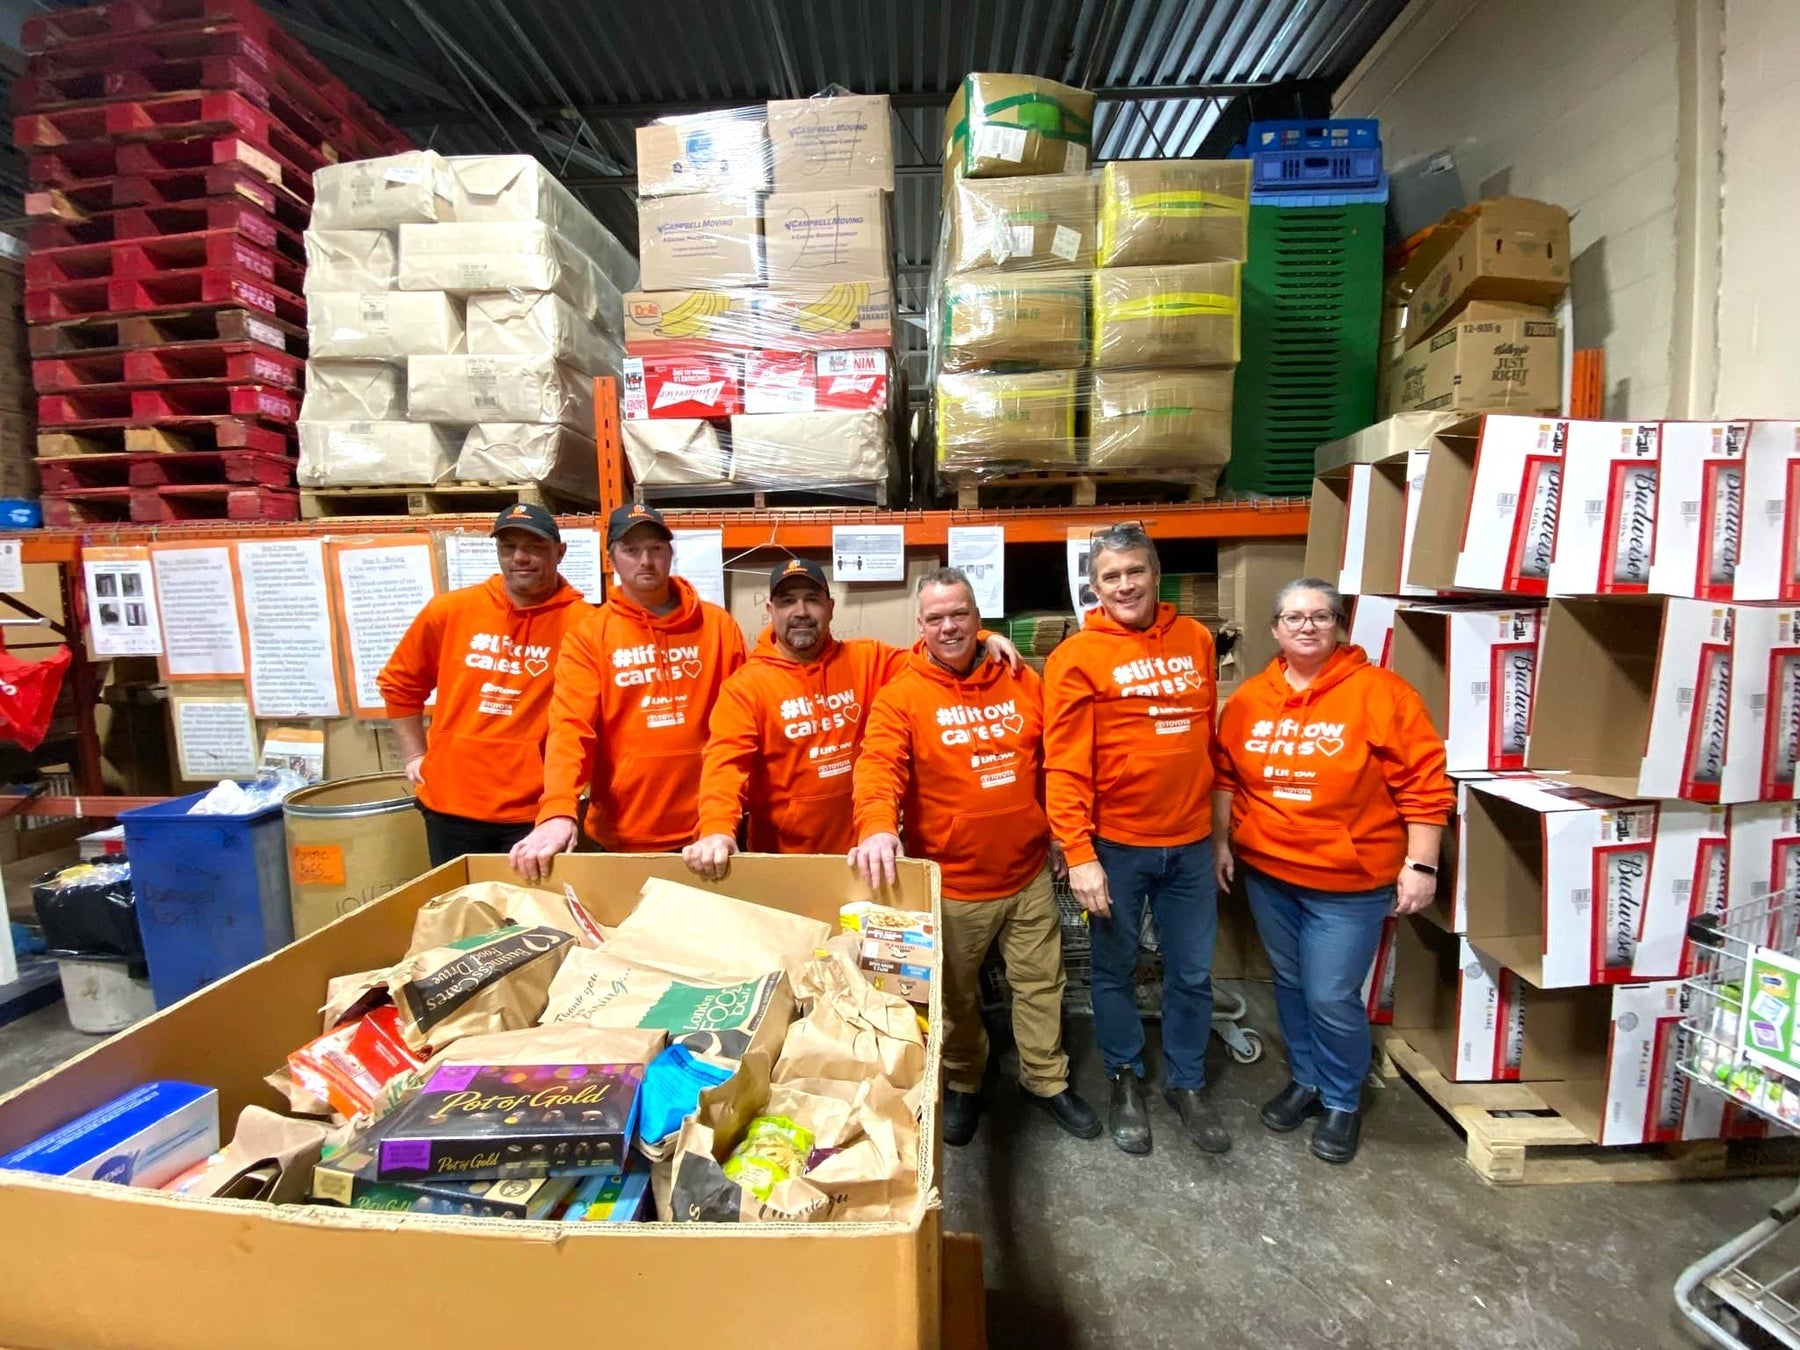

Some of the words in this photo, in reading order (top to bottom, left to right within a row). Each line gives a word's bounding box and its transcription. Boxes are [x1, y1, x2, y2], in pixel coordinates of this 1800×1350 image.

[634, 303, 658, 317] Dole
[853, 356, 875, 369] WIN
[1495, 357, 1526, 369] JUST
[1491, 369, 1529, 386] RIGHT
[1627, 470, 1657, 580] Budweiser
[470, 633, 552, 658] #lfow
[1284, 787, 1312, 796] TOYOTA
[1616, 853, 1643, 961] Budweiser
[469, 946, 504, 967] Food
[432, 965, 474, 986] Drive
[554, 994, 584, 1024] Thank
[584, 972, 600, 996] you
[683, 993, 716, 1031] London
[436, 1090, 497, 1117] Pot
[500, 1094, 527, 1111] of
[528, 1084, 611, 1108] Gold
[437, 1156, 458, 1174] Pot
[470, 1151, 501, 1170] Gold
[503, 1185, 525, 1197] 24
